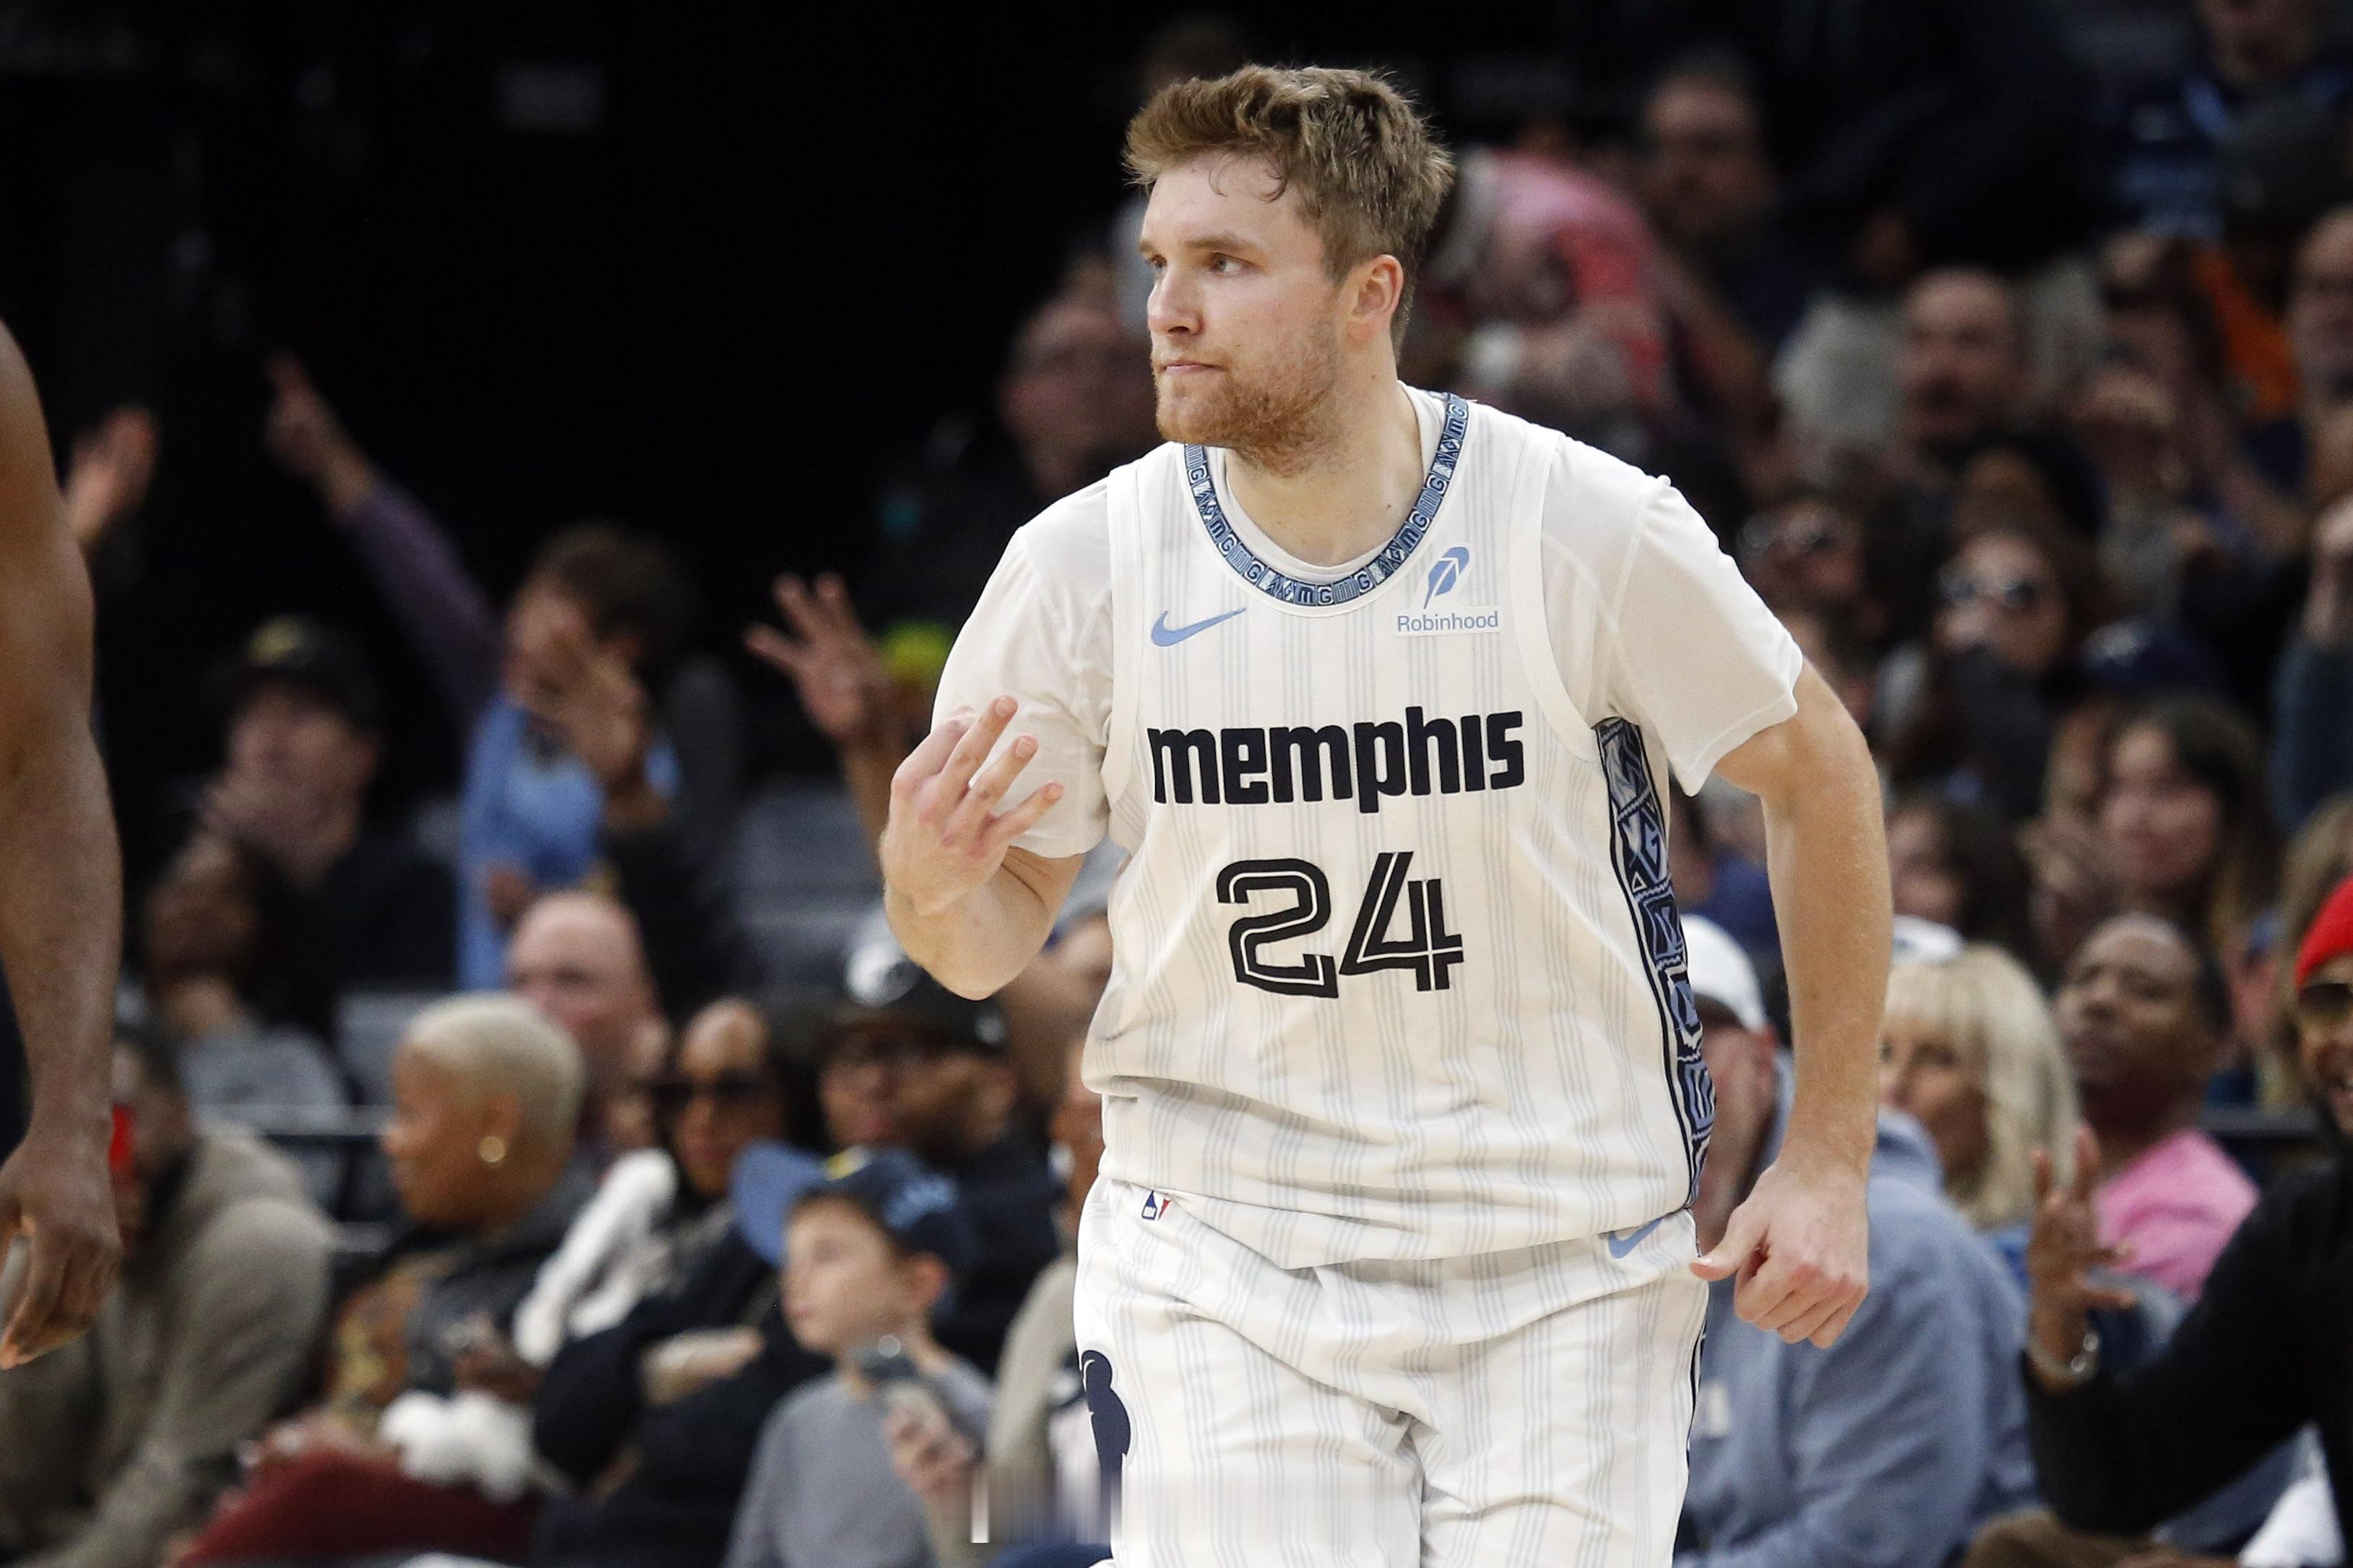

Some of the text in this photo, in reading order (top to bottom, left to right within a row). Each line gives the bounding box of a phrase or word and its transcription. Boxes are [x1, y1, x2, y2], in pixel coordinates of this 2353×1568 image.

[1397, 610, 1499, 632] Robinhood
[1147, 706, 1524, 813] memphis
[1216, 852, 1464, 998] 24
